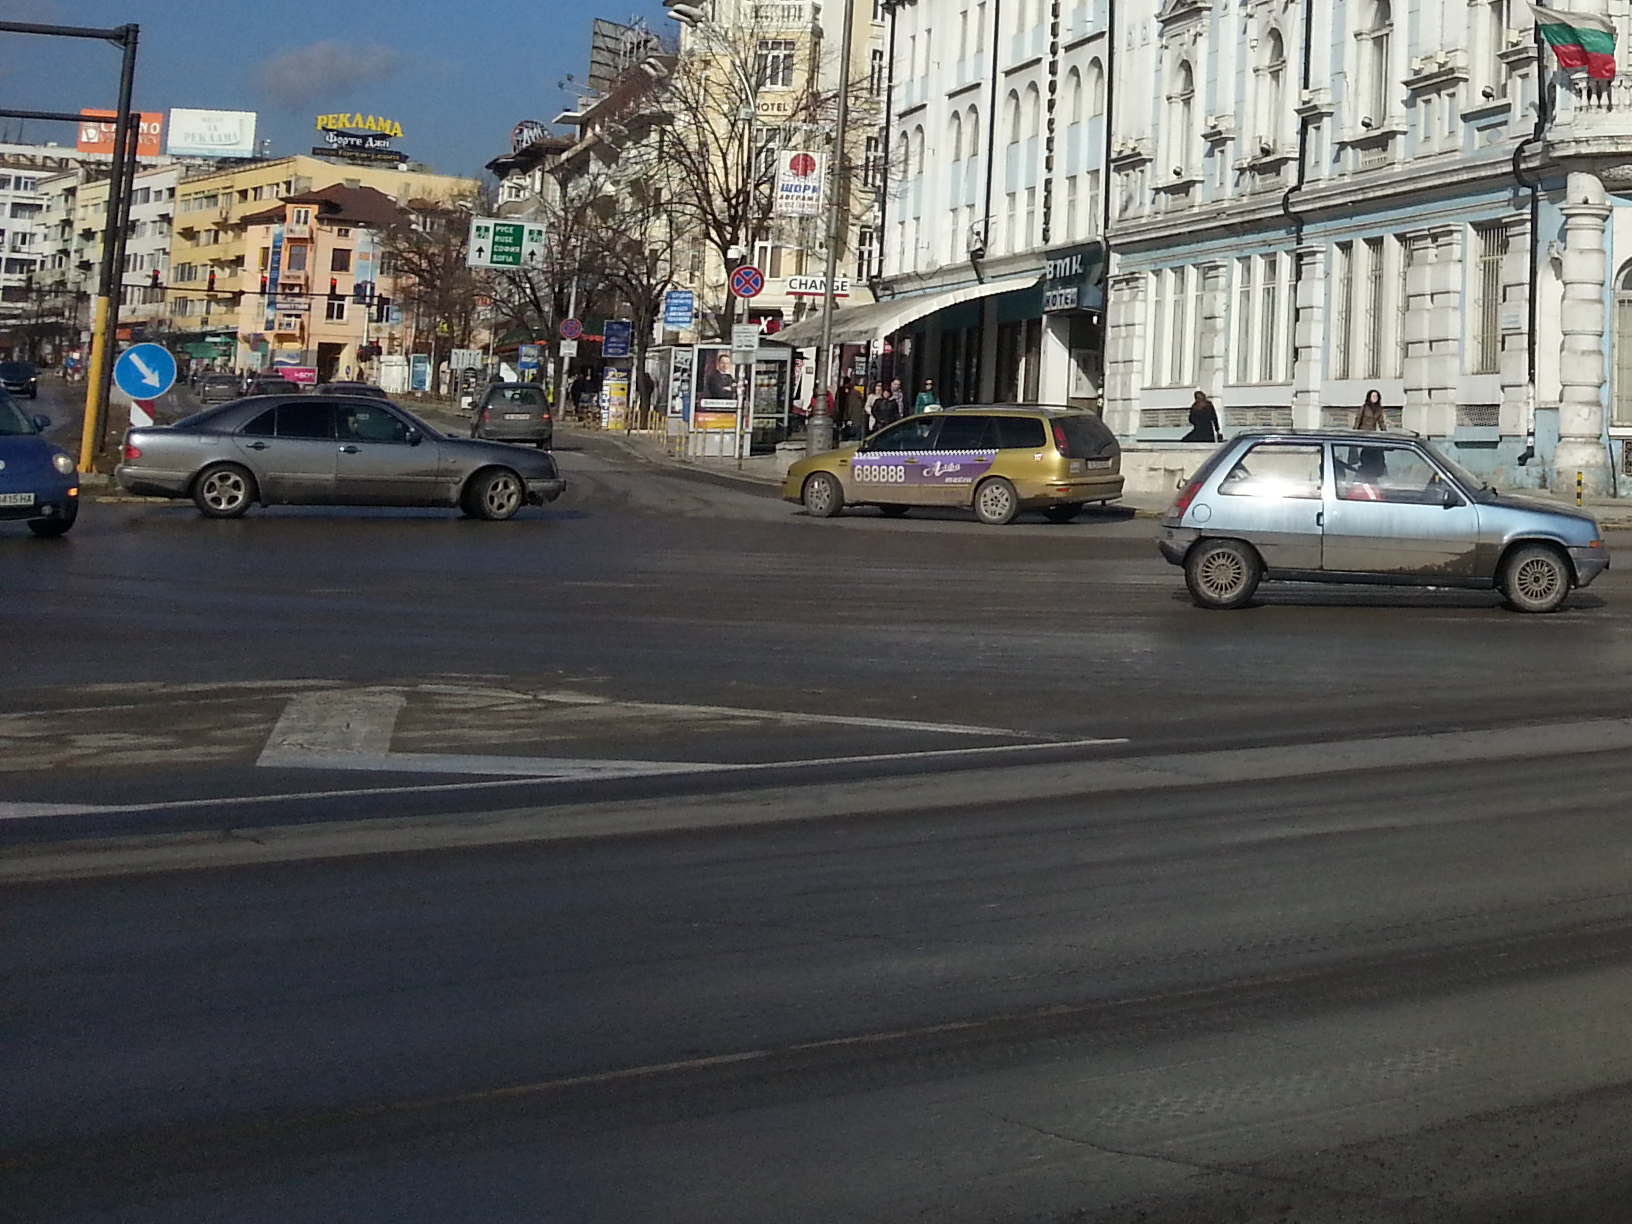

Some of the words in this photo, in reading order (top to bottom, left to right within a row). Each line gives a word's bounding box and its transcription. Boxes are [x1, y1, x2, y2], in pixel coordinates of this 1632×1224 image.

[756, 102, 788, 112] HOTEL
[316, 113, 404, 137] РЕКЛАМА
[325, 131, 363, 146] Форте
[493, 245, 520, 253] СОФИЯ
[492, 254, 513, 262] SOFIA
[855, 465, 905, 482] 688888
